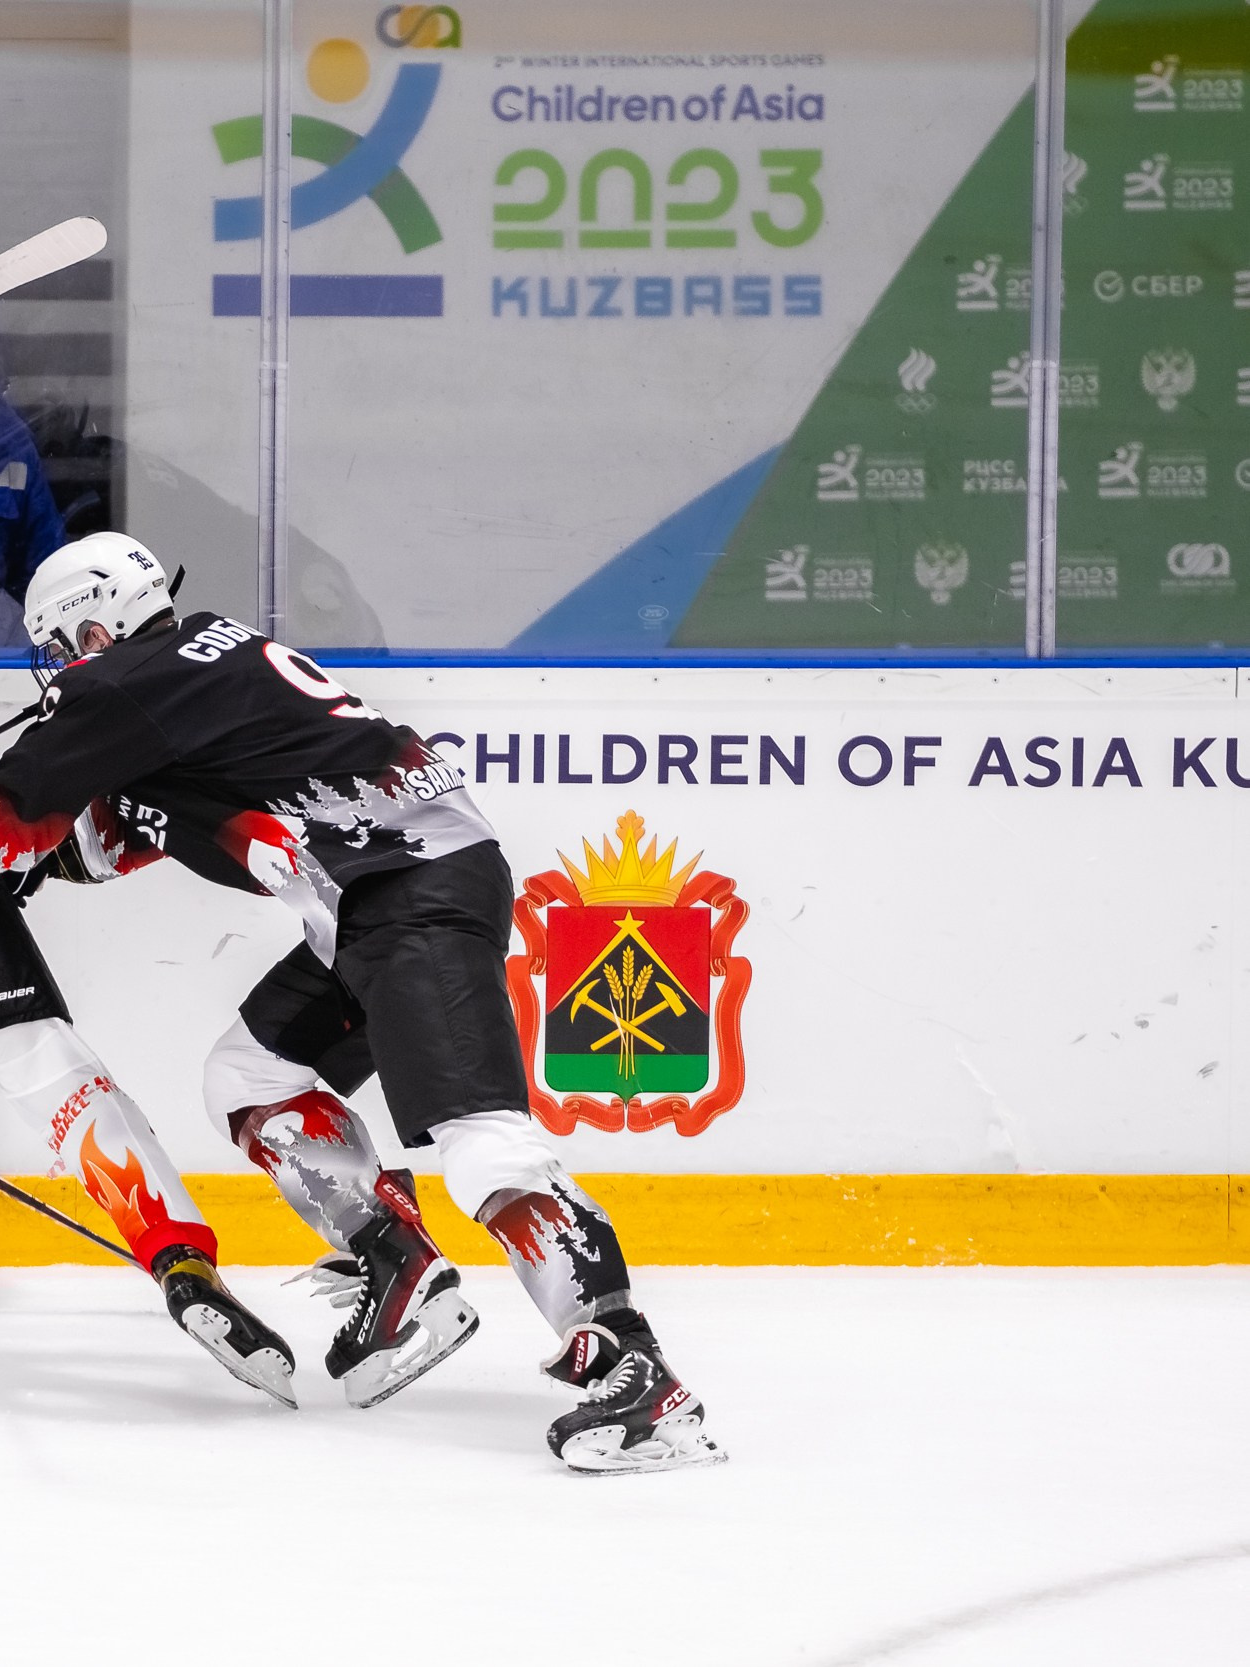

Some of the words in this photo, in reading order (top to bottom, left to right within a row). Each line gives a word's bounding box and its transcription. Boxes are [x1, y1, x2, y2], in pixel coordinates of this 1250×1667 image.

[521, 55, 580, 67] WINTER
[584, 55, 705, 67] INTERNATIONAL
[709, 55, 768, 67] SPORTS
[771, 54, 825, 66] GAMES
[1183, 78, 1244, 99] 2023
[491, 84, 676, 122] Children
[681, 84, 727, 122] of
[730, 84, 825, 122] Asia
[1174, 177, 1233, 198] 2023
[493, 148, 825, 249] 2023
[492, 275, 822, 318] KUZBASS
[1132, 275, 1203, 297] СБЕР
[866, 468, 925, 487] 2023
[1148, 465, 1207, 485] 2023
[813, 568, 872, 588] 2023
[1058, 566, 1118, 586] 2023
[62, 593, 90, 612] CCM
[837, 735, 942, 787] OF
[968, 736, 1143, 788] ASIA
[382, 1182, 419, 1216] CCM
[357, 1298, 377, 1345] CCM
[574, 1336, 587, 1373] CCM
